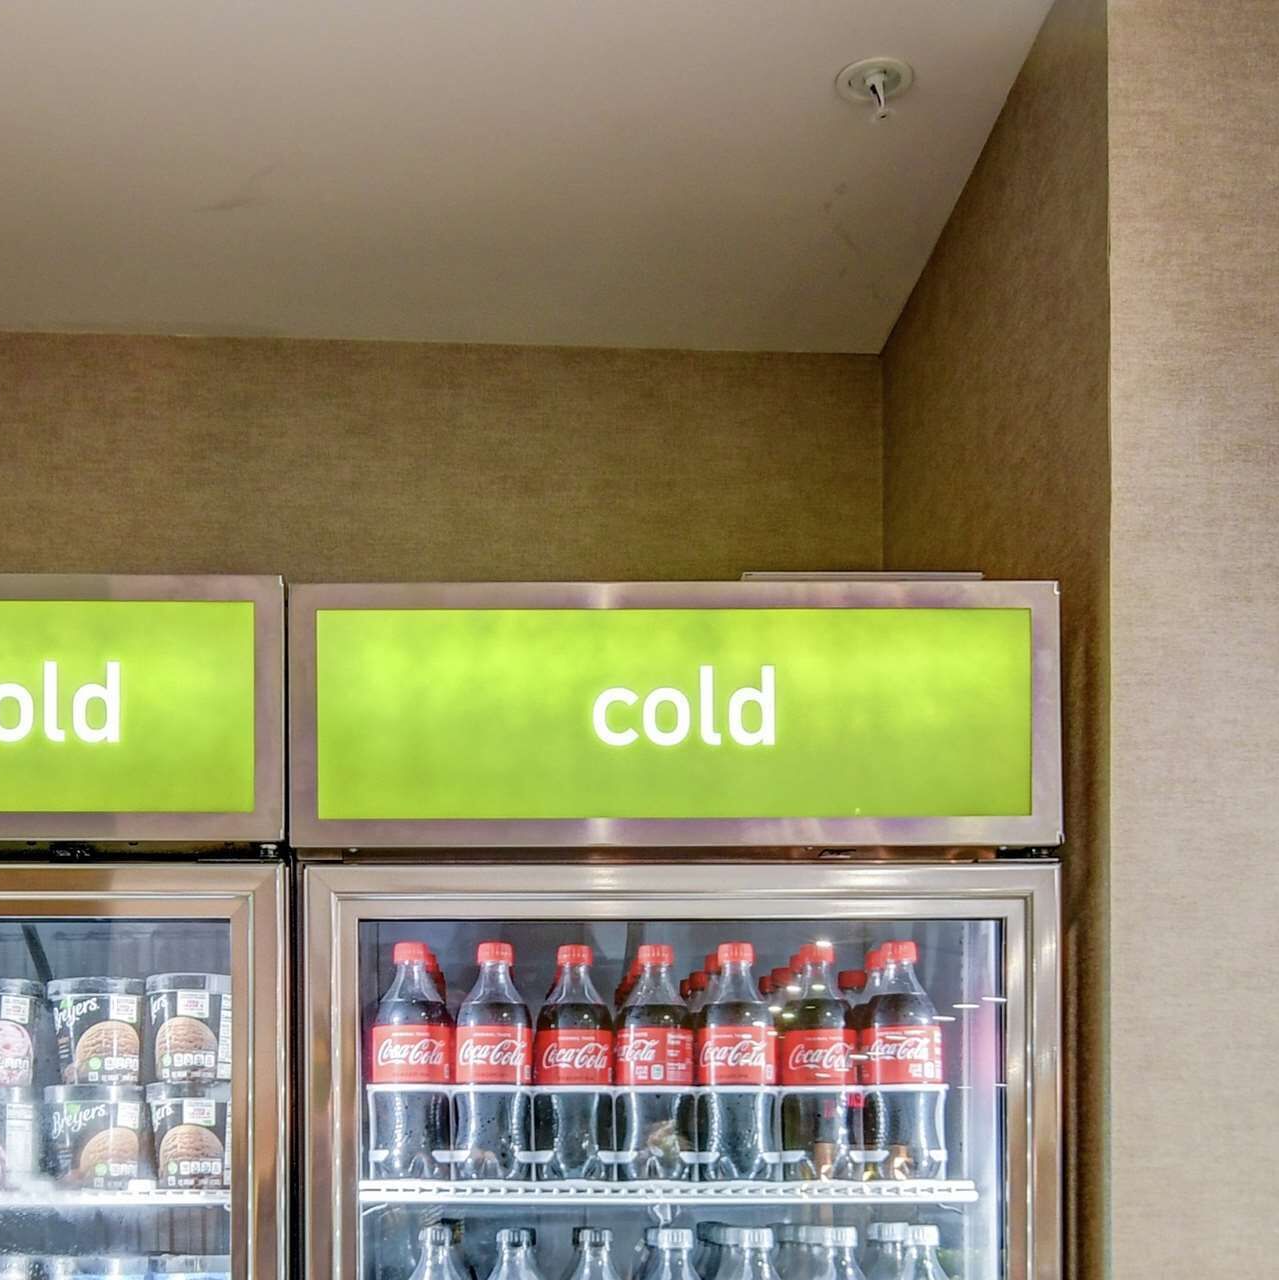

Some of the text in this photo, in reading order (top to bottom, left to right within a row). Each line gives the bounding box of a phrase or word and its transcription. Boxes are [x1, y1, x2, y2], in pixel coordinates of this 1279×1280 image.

[591, 664, 778, 747] cold
[378, 1038, 446, 1066] Coca-Cola
[459, 1038, 527, 1066] Coca-Cola
[543, 1043, 609, 1069] Coca-Cola
[700, 1039, 767, 1067] Coca-Cola
